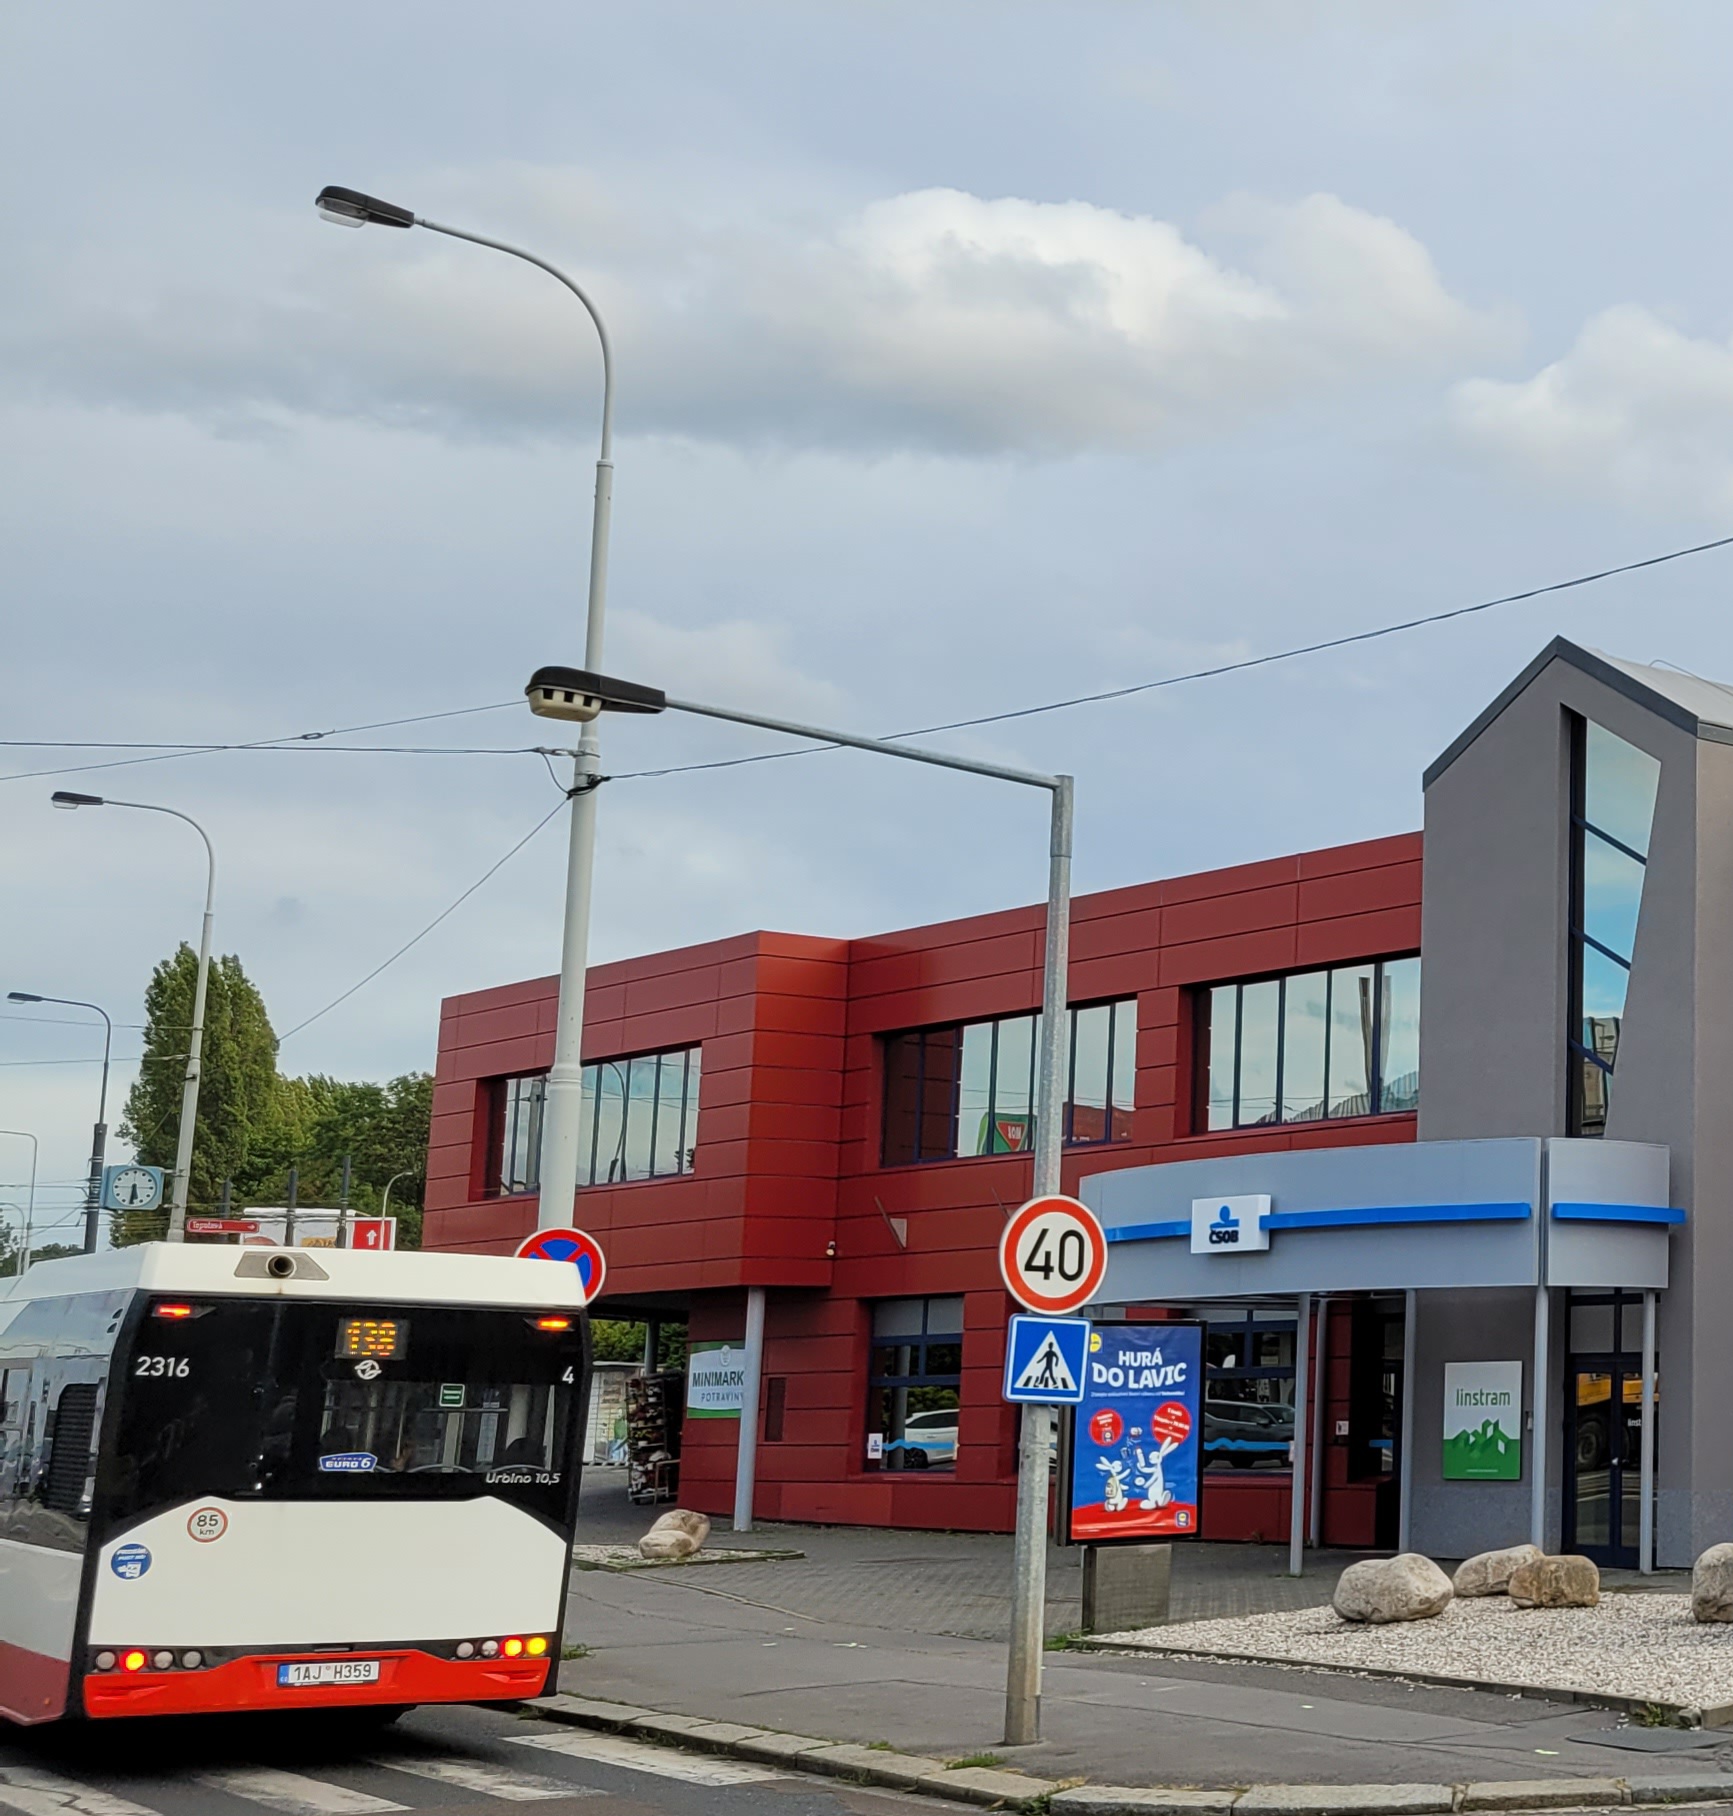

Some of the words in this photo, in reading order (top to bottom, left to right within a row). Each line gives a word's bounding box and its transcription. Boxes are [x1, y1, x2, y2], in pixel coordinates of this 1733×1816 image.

[1208, 1228, 1239, 1245] ČSOB
[1024, 1227, 1085, 1282] 40
[1118, 1347, 1163, 1367] HURÁ
[135, 1355, 190, 1378] 2316
[561, 1366, 575, 1385] 4
[1091, 1362, 1125, 1388] DO
[1128, 1362, 1188, 1389] LAVIC
[692, 1370, 745, 1388] MINIMARK
[1456, 1387, 1511, 1407] linstram
[1627, 1417, 1642, 1427] linst
[325, 1460, 359, 1469] EURO
[360, 1457, 372, 1468] 6
[486, 1472, 532, 1484] Urbino
[534, 1472, 561, 1486] 10,5
[196, 1514, 219, 1528] 85
[199, 1527, 215, 1536] km
[294, 1665, 322, 1681] 1AJ
[333, 1663, 372, 1679] H359
